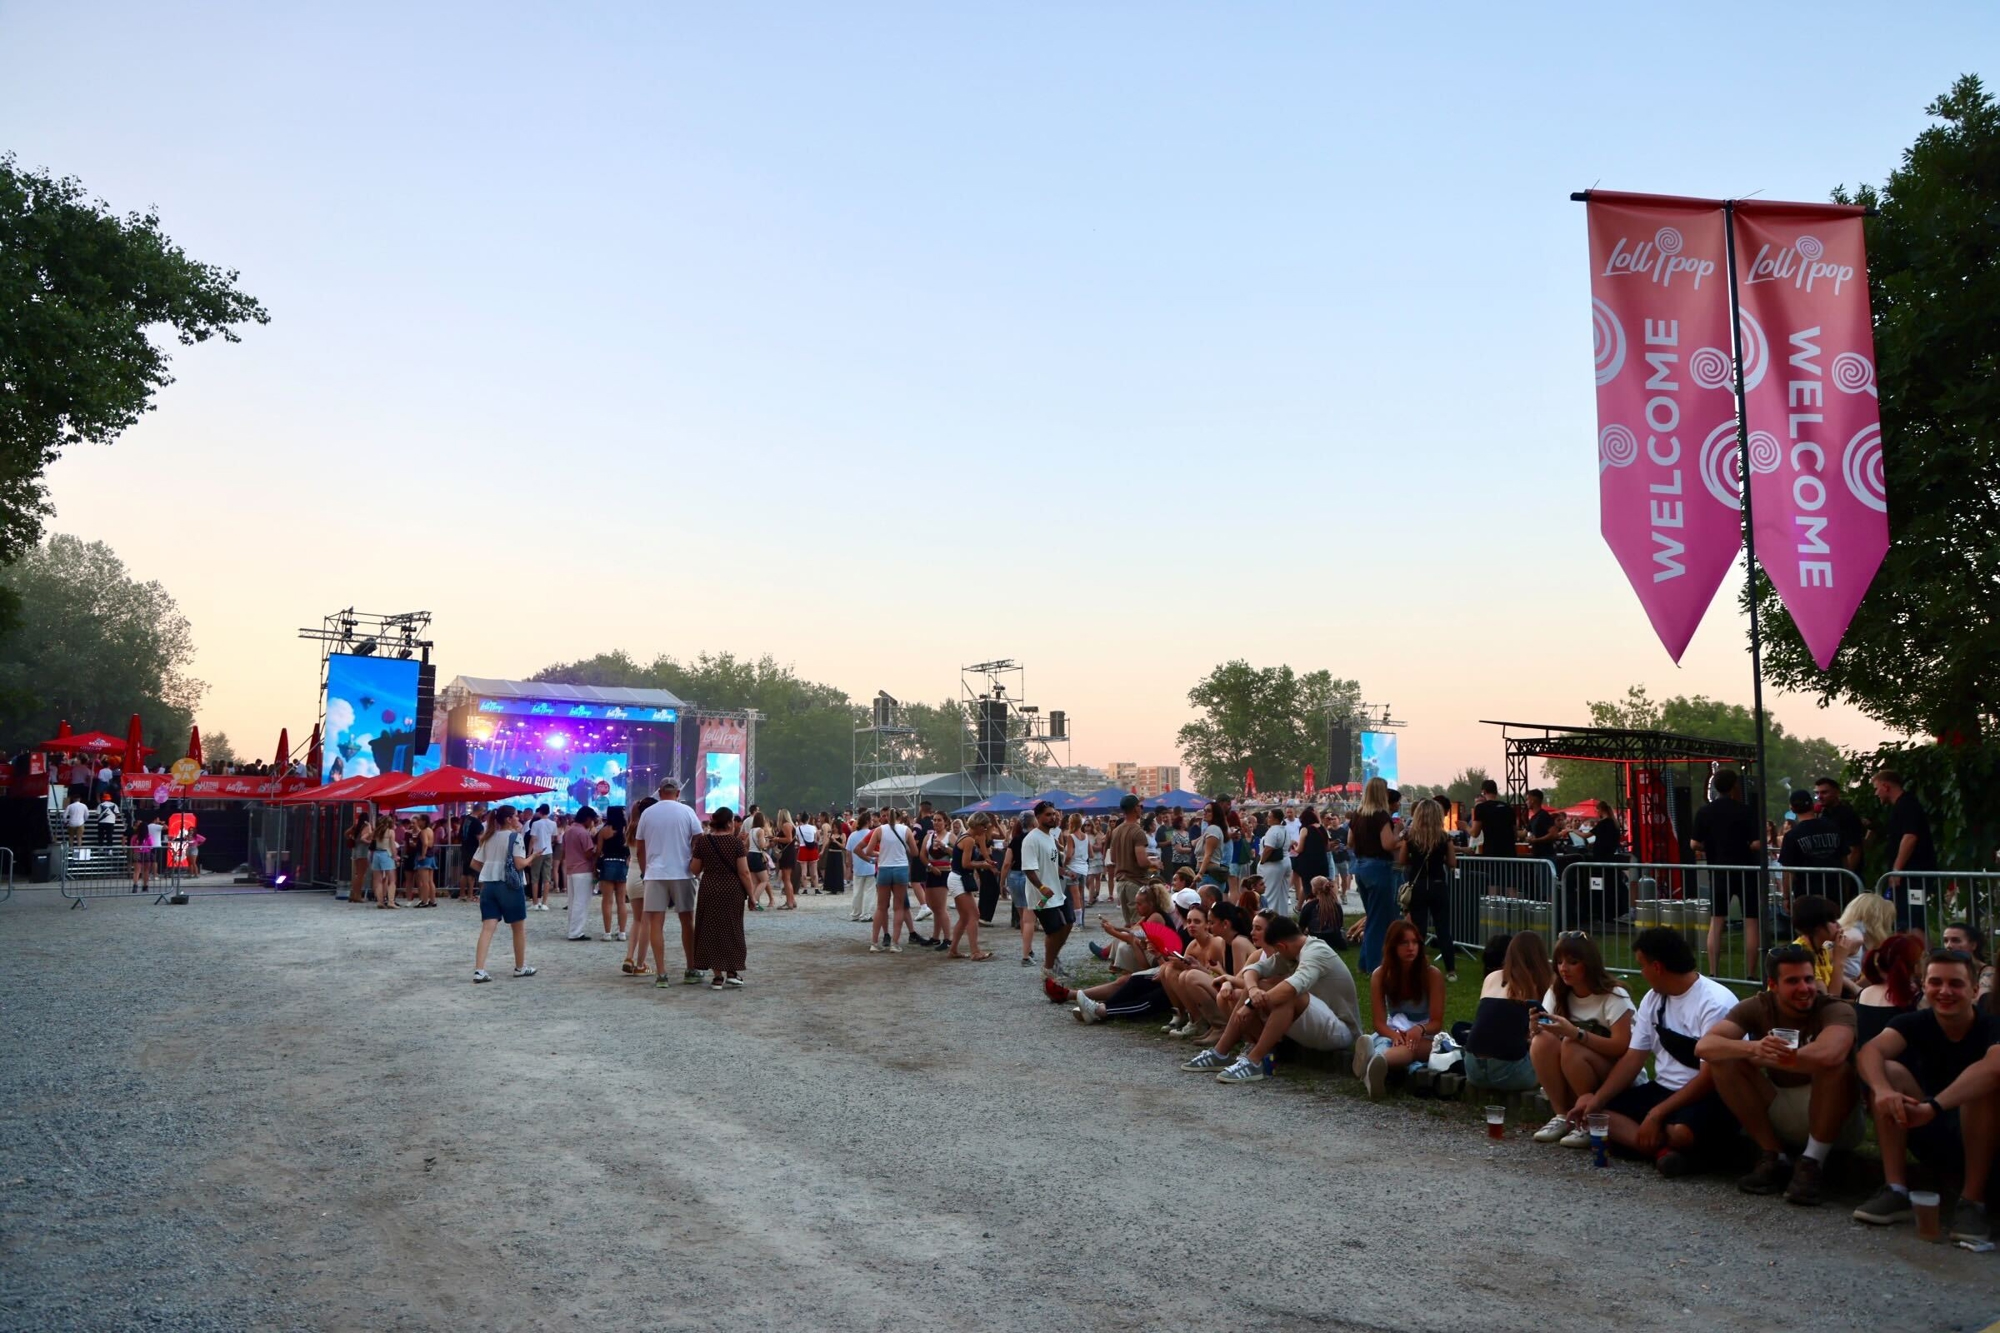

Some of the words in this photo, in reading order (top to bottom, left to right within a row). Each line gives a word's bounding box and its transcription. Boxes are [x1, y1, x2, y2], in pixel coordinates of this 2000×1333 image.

[1645, 318, 1686, 583] WELCOME
[1788, 326, 1834, 588] WELCOME
[178, 763, 195, 772] VIP
